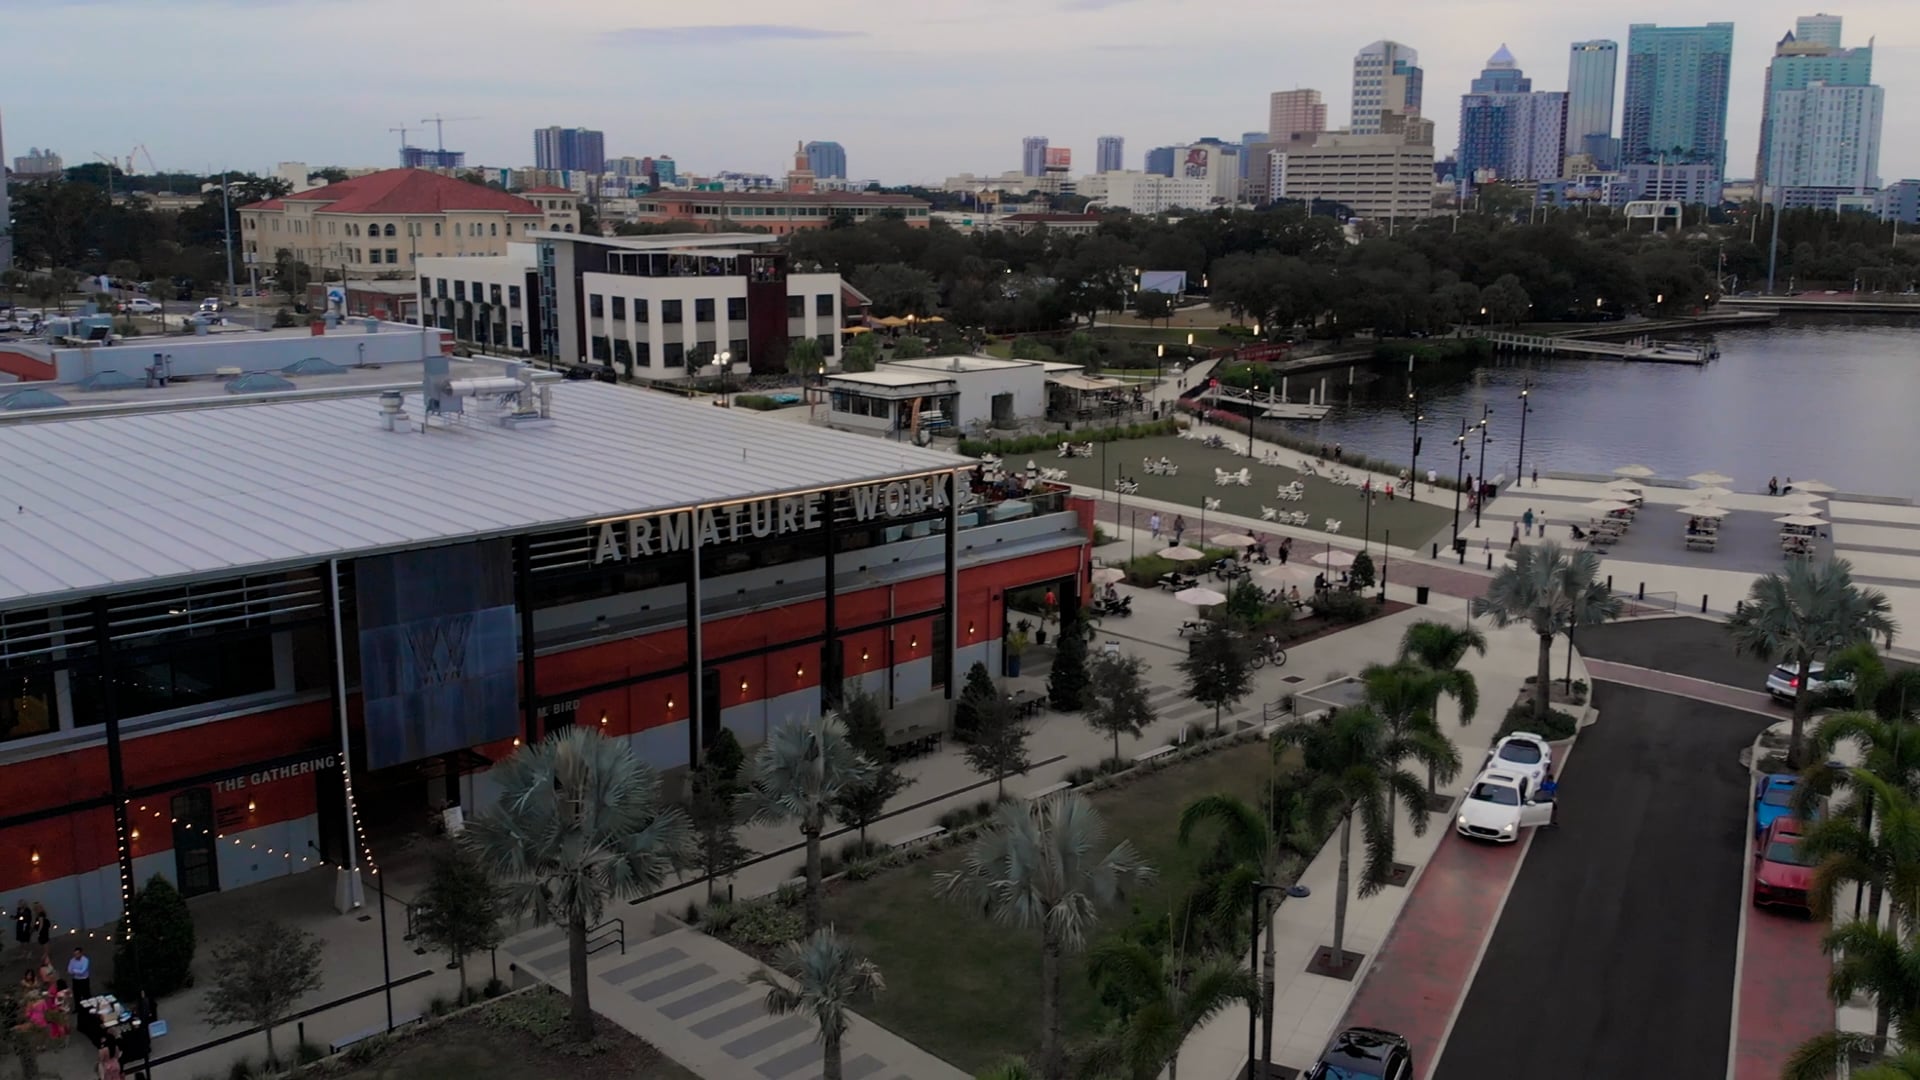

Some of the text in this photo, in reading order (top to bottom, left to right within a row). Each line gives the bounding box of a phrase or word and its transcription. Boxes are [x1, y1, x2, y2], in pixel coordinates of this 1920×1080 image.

[594, 493, 822, 564] ARMATURE
[553, 700, 580, 714] BIRD
[215, 756, 335, 793] THE GATHERING
